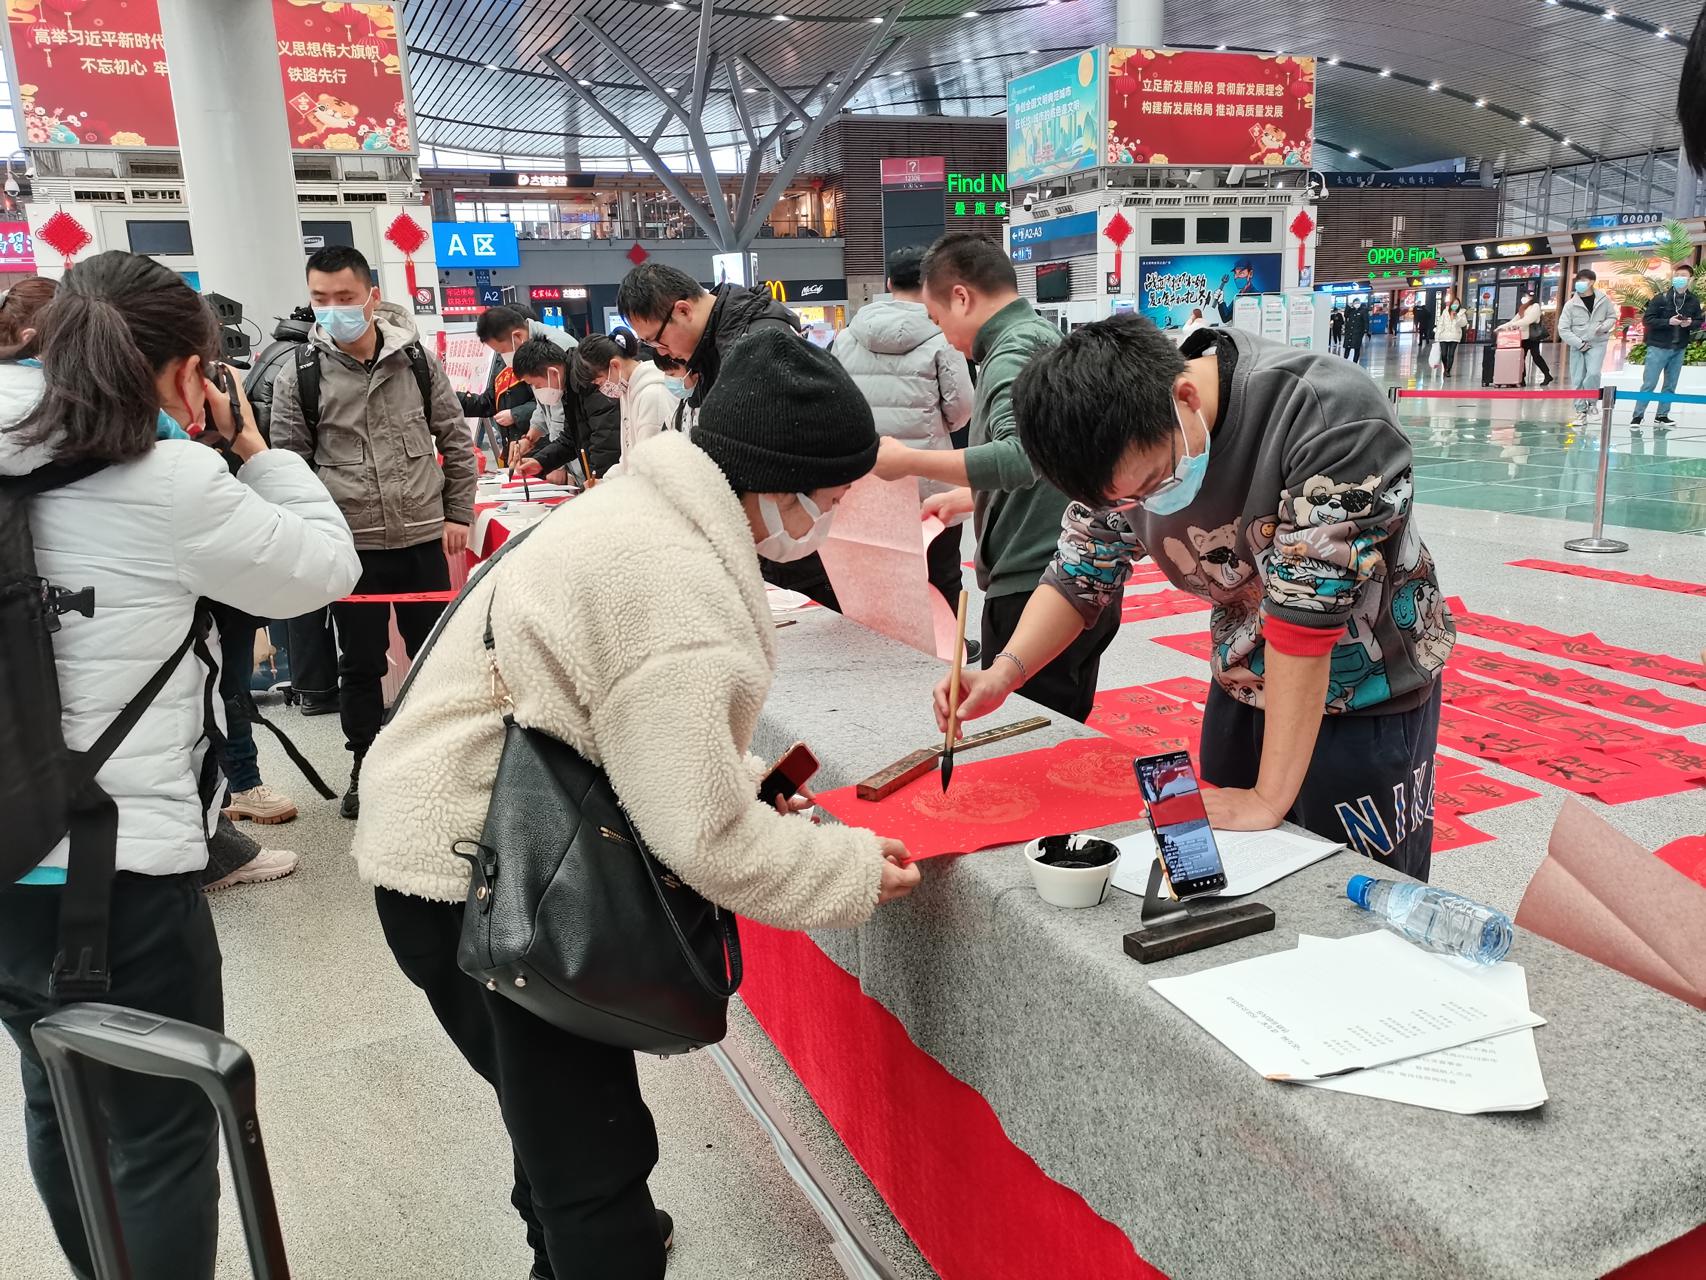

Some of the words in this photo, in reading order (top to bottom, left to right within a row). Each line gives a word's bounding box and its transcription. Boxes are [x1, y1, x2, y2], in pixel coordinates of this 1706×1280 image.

[33, 28, 165, 50] 高举习近平新时代
[278, 40, 381, 60] 义思想伟大旗帜
[80, 57, 148, 76] 不忘初心
[287, 67, 347, 84] 铁路先行
[1142, 79, 1214, 95] 立足新发展阶段
[1216, 82, 1285, 97] 贯彻新发展理念
[1142, 101, 1213, 117] 构建新发展格局
[1216, 103, 1284, 118] 推动高质量发展
[948, 173, 985, 193] Find
[992, 173, 1005, 193] N
[1368, 248, 1405, 265] OPPO
[1408, 247, 1436, 264] Find
[484, 291, 500, 301] A2
